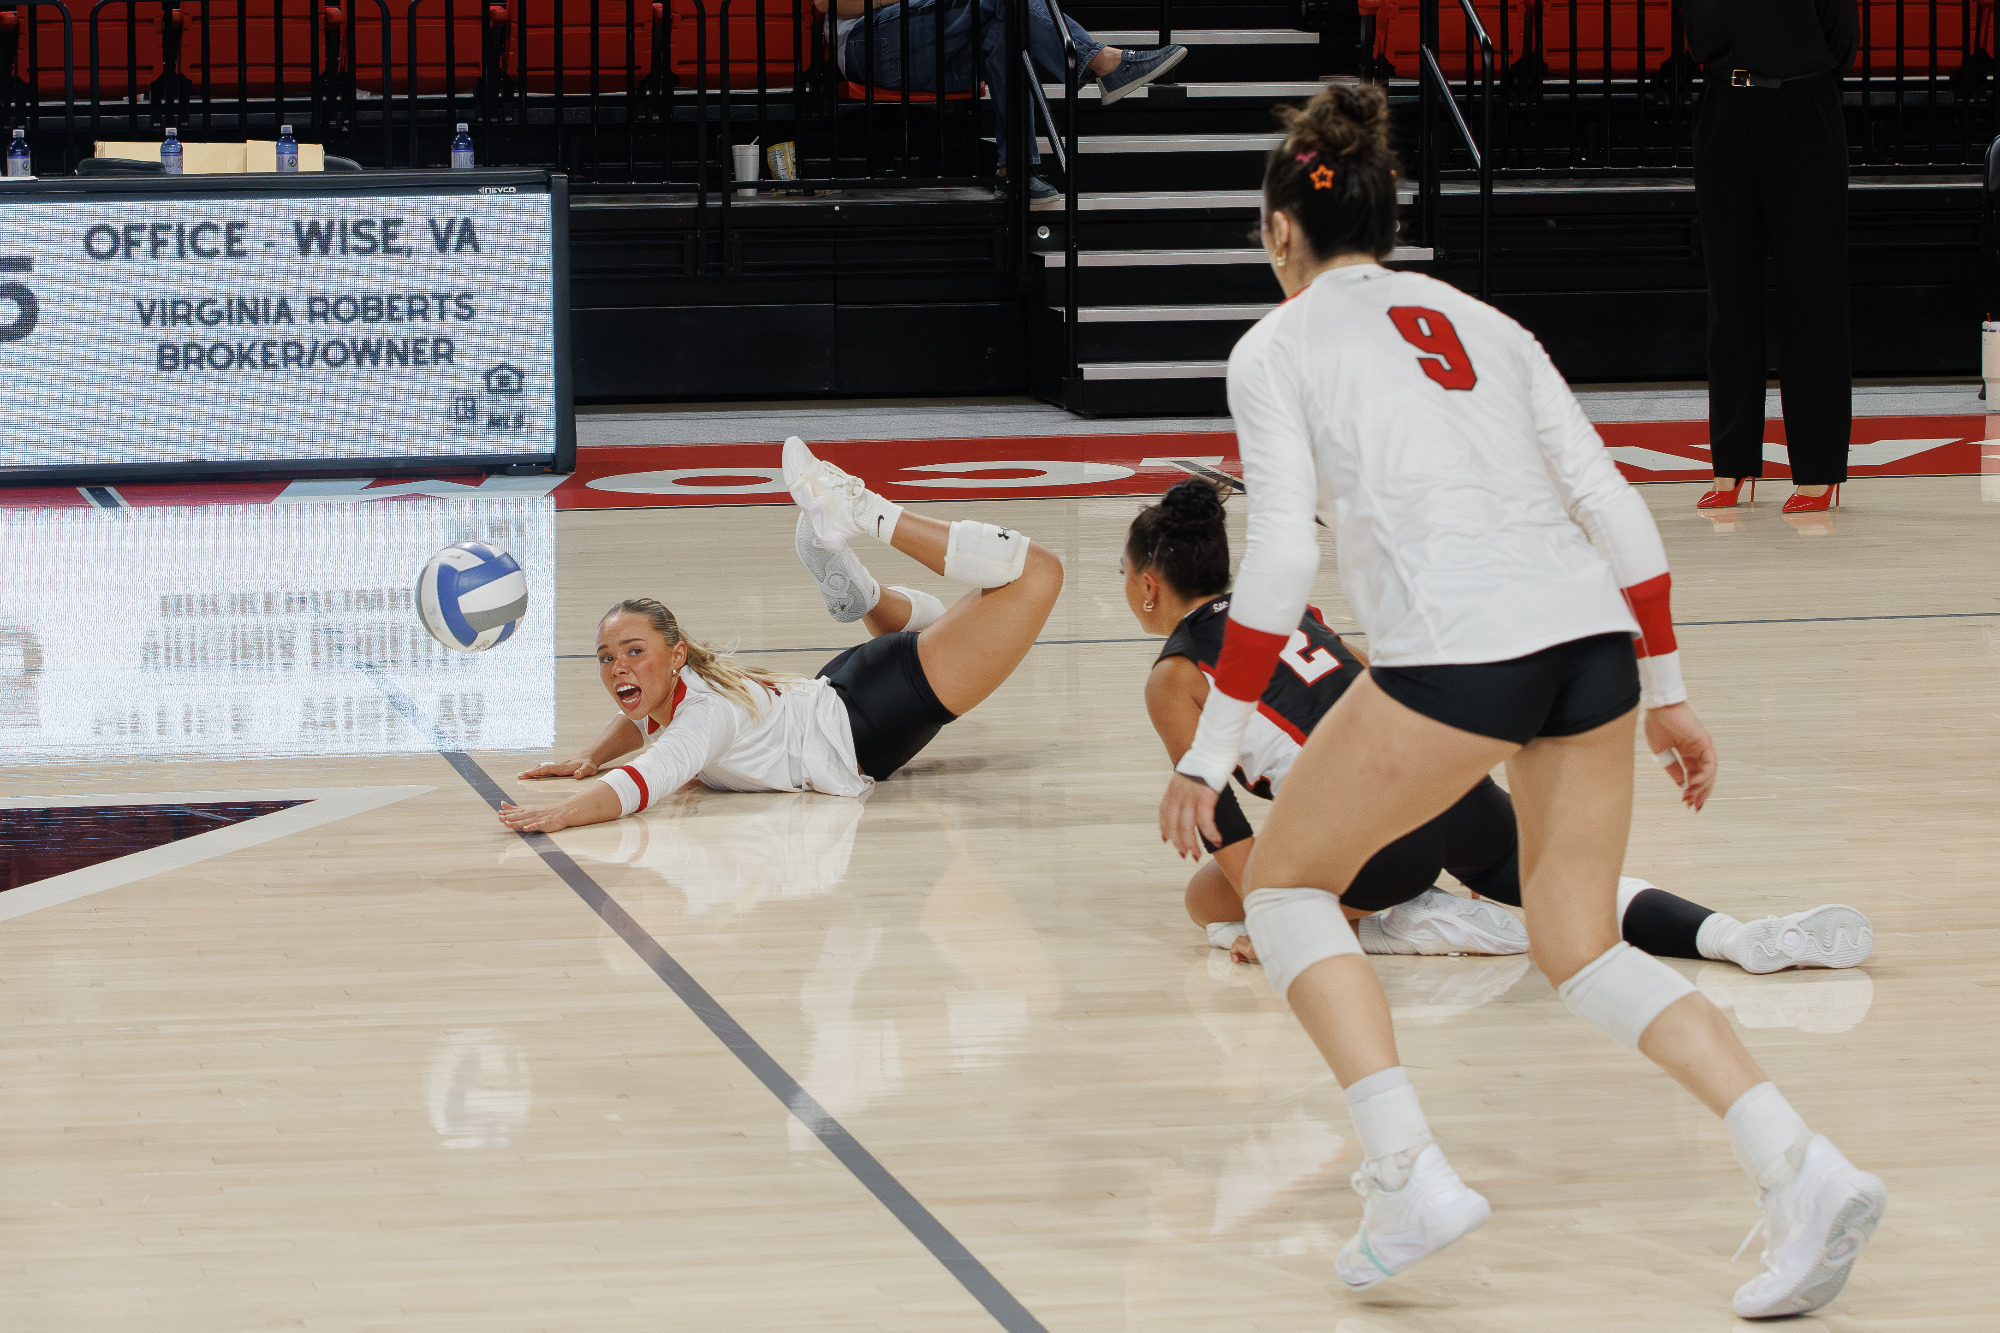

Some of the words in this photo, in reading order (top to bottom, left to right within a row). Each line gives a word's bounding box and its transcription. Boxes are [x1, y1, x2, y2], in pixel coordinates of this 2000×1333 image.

[84, 221, 249, 260] OFFICE
[293, 218, 413, 258] WISE,
[427, 216, 481, 254] VA
[136, 297, 295, 327] VIRGINIA
[307, 291, 477, 323] ROBERTS
[157, 337, 456, 372] BROKER/OWNER
[1387, 305, 1478, 391] 9
